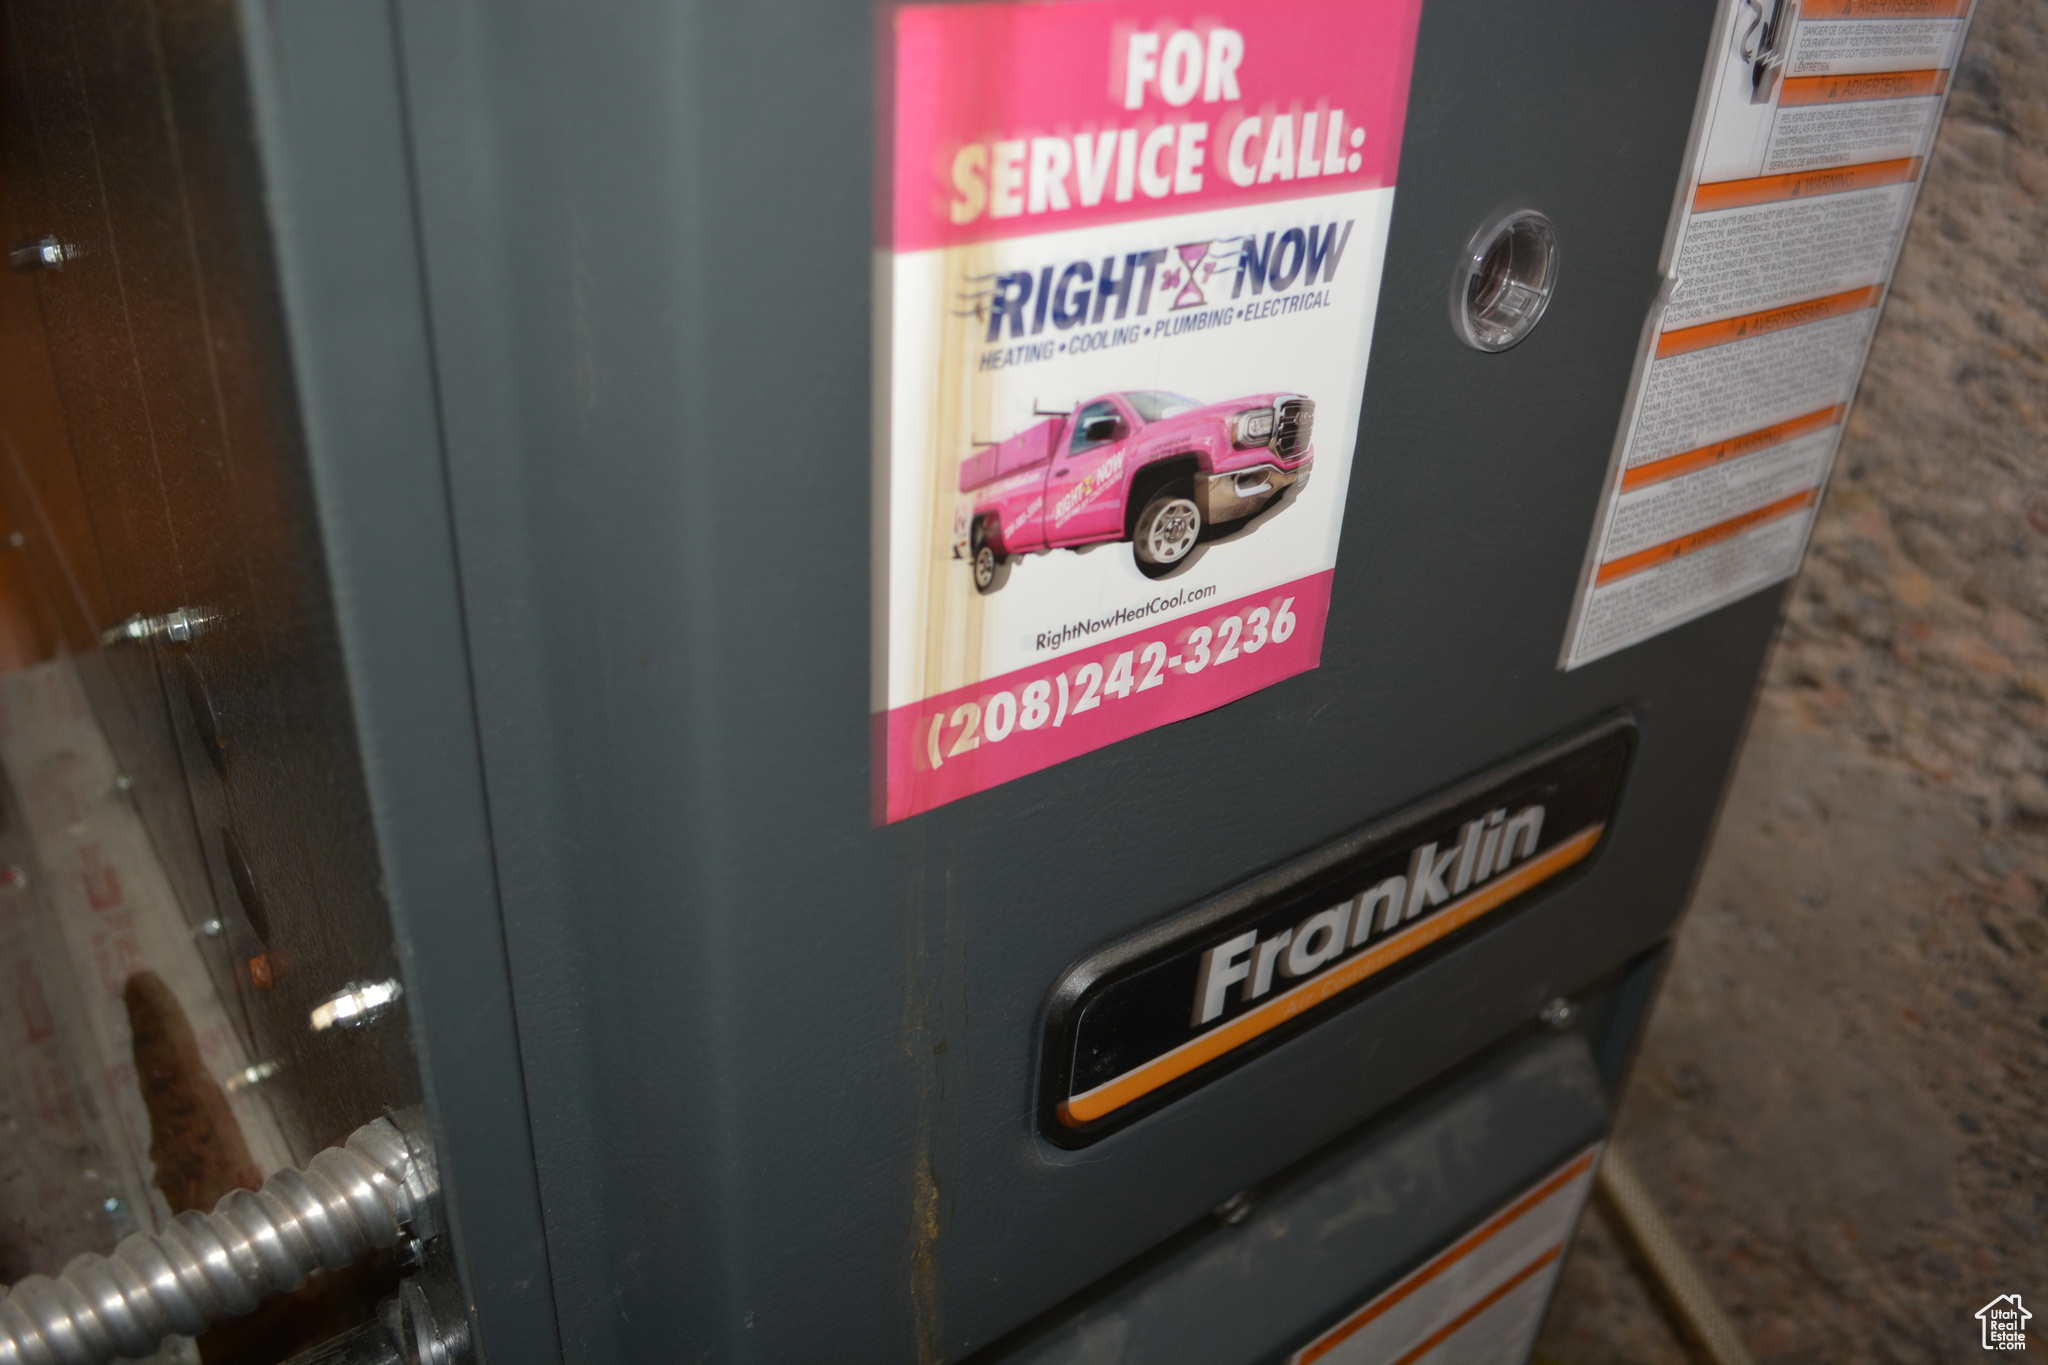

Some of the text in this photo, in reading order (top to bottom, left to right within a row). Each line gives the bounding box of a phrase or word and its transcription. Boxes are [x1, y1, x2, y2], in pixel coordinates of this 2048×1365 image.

[1802, 26, 1828, 35] DANGER
[1836, 25, 1855, 35] CHOC
[1798, 37, 1829, 48] COURANT
[1828, 37, 1849, 47] AVANT
[1847, 36, 1864, 46] TOUT
[1124, 28, 1245, 110] FOR
[1842, 77, 1915, 96] ADVERTENCIA
[1780, 112, 1807, 123] PELIGRO
[1815, 109, 1841, 120] CHOQUE
[1777, 124, 1799, 135] TODAS
[1798, 123, 1811, 133] LAS
[1810, 120, 1837, 132] FUENTES
[1771, 147, 1789, 159] DEBE
[952, 110, 1366, 224] SERVICE CALL:
[1801, 170, 1855, 193] WARNING
[1687, 218, 1718, 232] HEATING
[1717, 215, 1737, 227] UNITS
[1736, 211, 1763, 224] SHOULD
[1761, 209, 1776, 220] NOT
[1682, 243, 1702, 255] SUCH
[1701, 239, 1726, 252] DEVICE
[1732, 233, 1762, 247] LOCATED
[1761, 230, 1776, 242] WILL
[1679, 254, 1705, 267] DEVICE
[1711, 246, 1747, 261] ROUTINELY
[986, 220, 1354, 342] RIGHT NOW
[1676, 266, 1694, 279] THAT
[1692, 264, 1708, 276] THE
[1693, 272, 1721, 286] SHOULD
[1683, 285, 1709, 299] WATER
[1707, 280, 1734, 294] SOURCE
[1665, 311, 1684, 324] SUCH
[978, 290, 1331, 372] HEATING COOLING PLUMBING ELECTRICAL
[1035, 582, 1217, 652] RightNowHeatCool.com
[926, 596, 1298, 769] (208)242-3236
[1193, 803, 1546, 1029] Franklin
[1283, 992, 1317, 1018] Air
[1319, 926, 1441, 998] Conditioning
